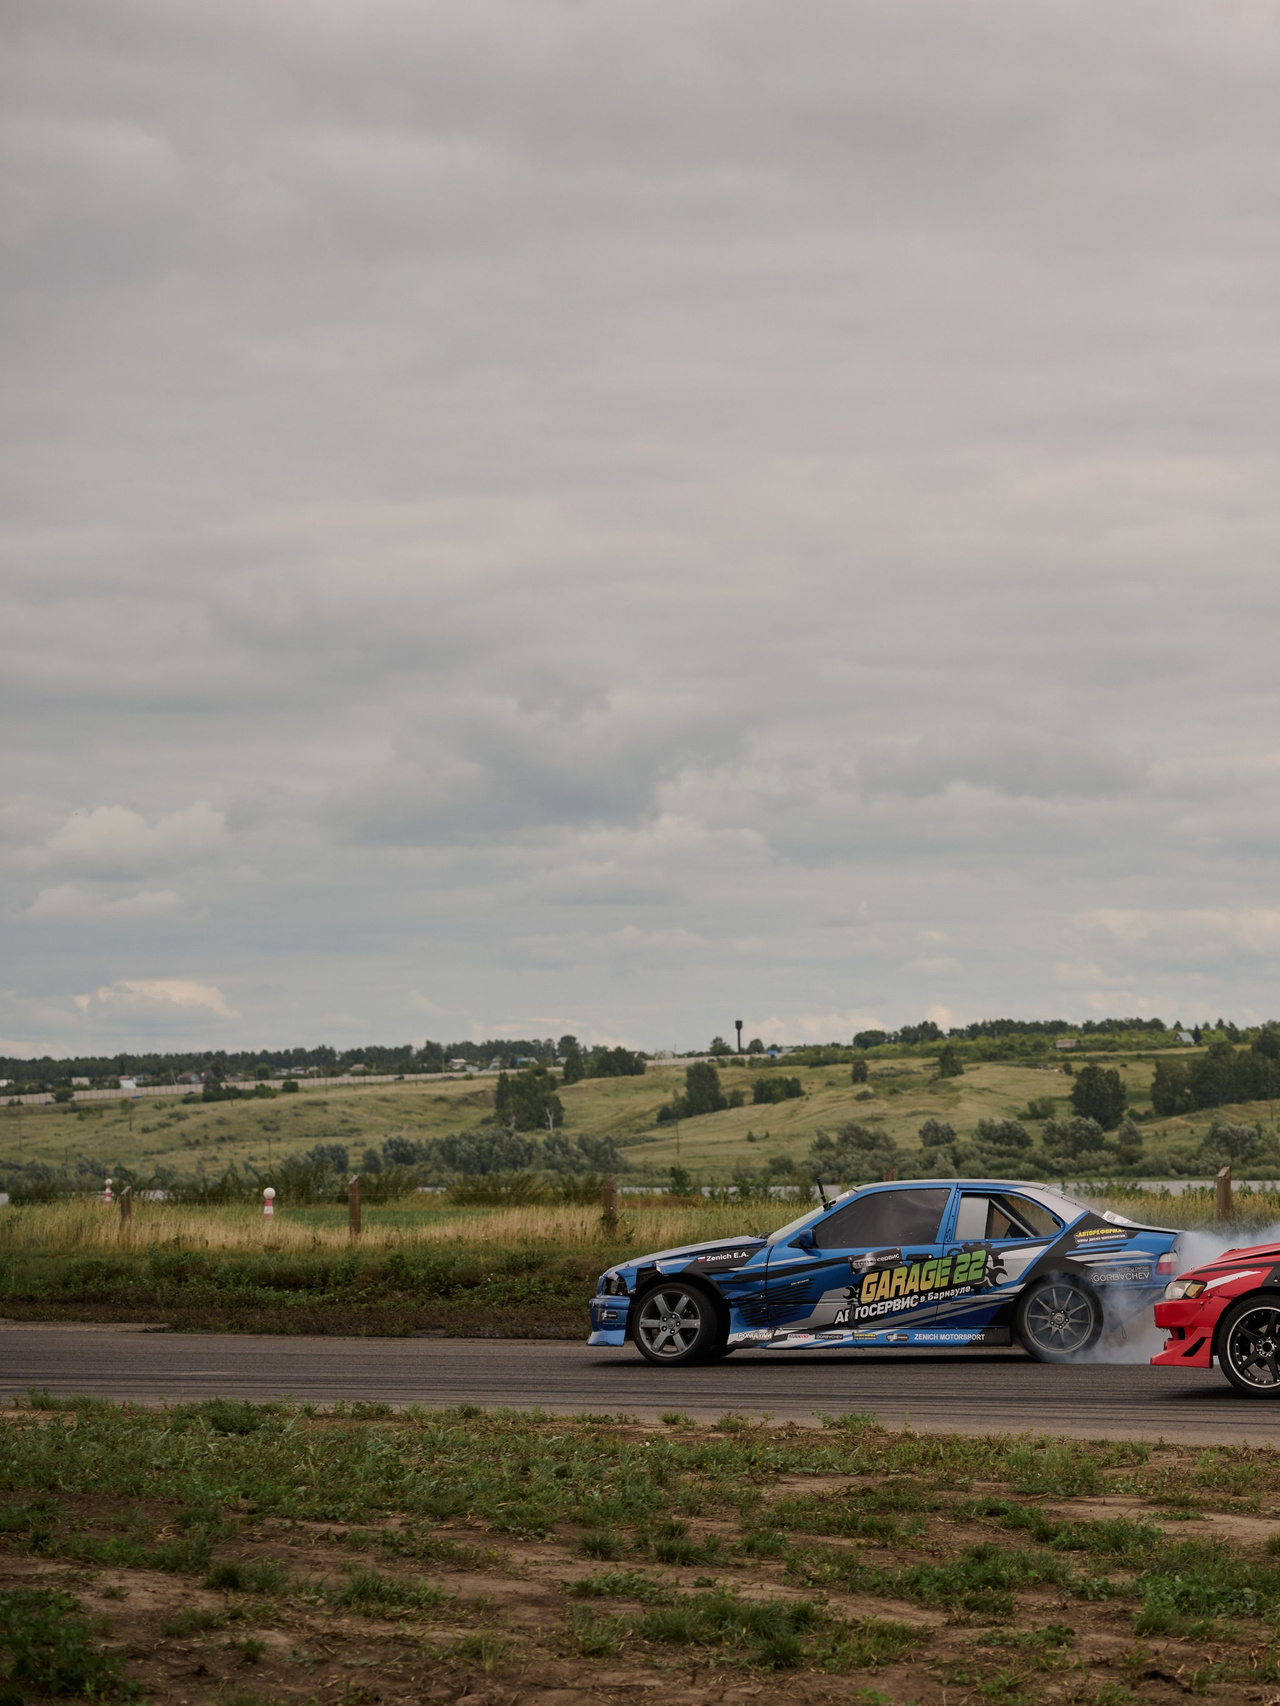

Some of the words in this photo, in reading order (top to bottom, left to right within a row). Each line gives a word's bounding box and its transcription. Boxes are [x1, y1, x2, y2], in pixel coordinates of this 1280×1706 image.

[706, 1253, 732, 1262] Zenich
[733, 1251, 749, 1259] E.A.
[860, 1256, 953, 1304] GARAGE
[952, 1250, 987, 1285] 22
[914, 1333, 939, 1341] ZENICH
[939, 1333, 986, 1341] MOTORSPORT
